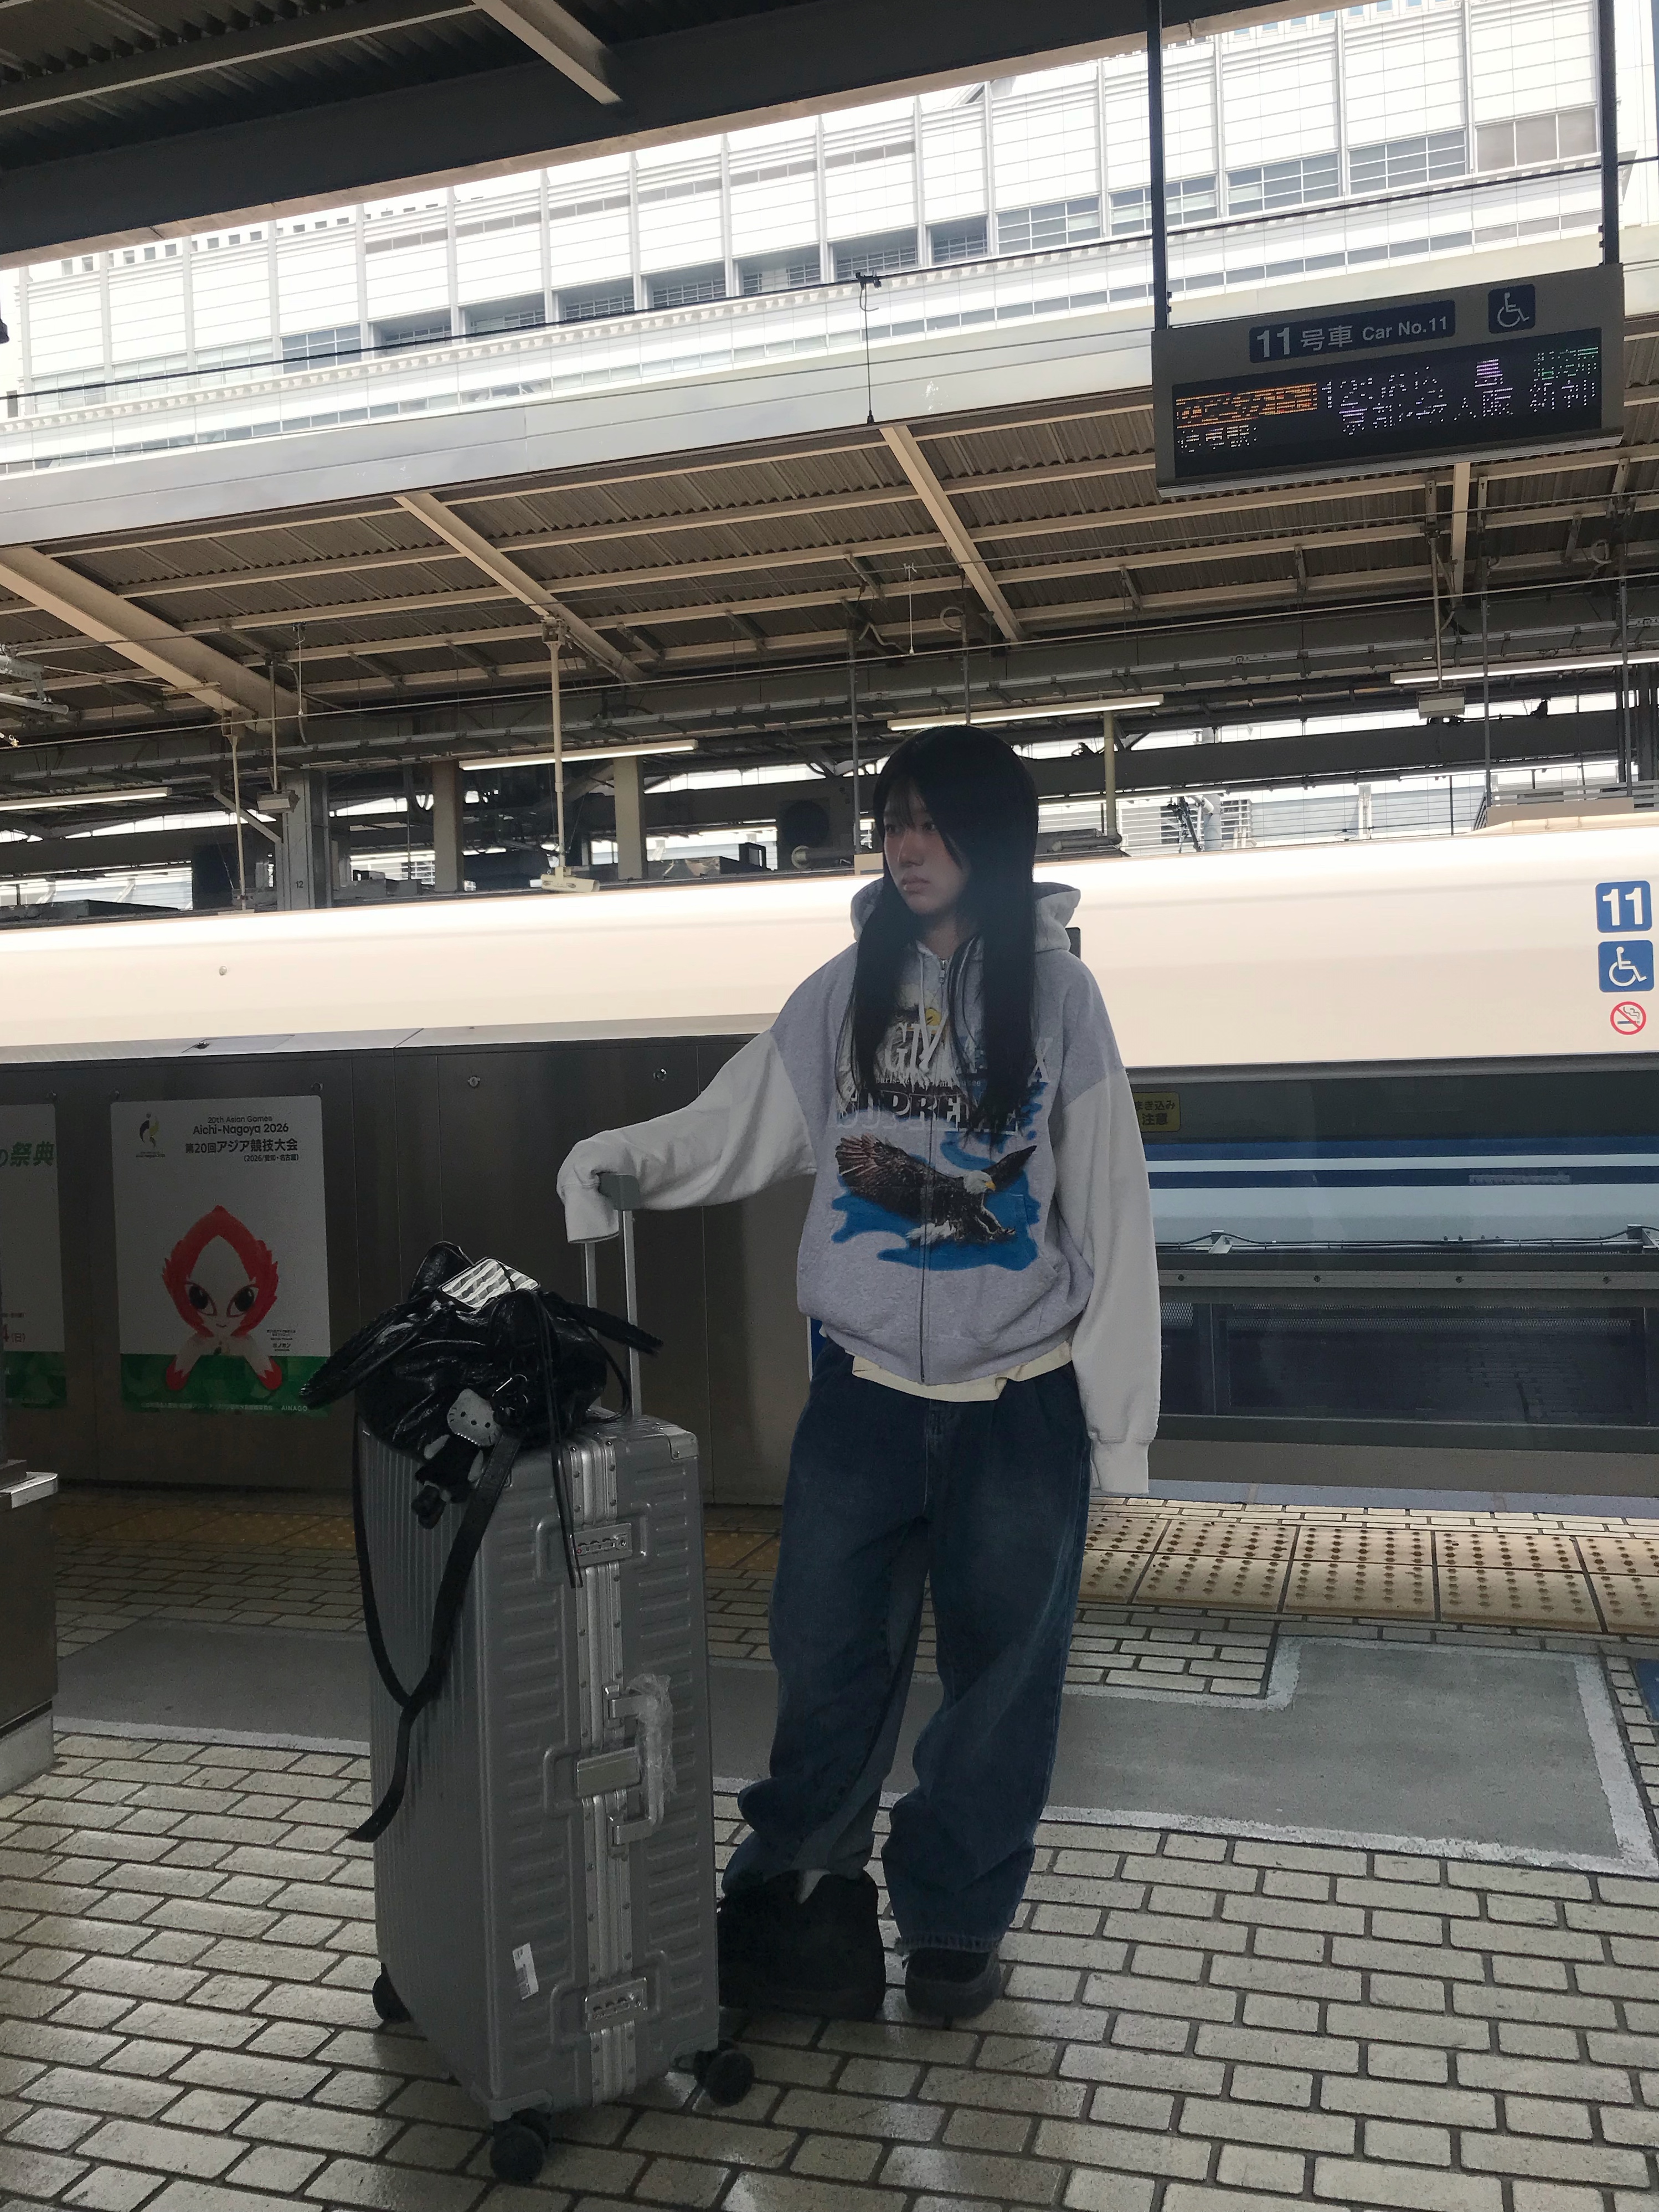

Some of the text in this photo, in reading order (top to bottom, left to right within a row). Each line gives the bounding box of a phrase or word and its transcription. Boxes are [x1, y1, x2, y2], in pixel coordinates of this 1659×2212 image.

[1256, 316, 1447, 358] 11号車 Car No.11
[1603, 887, 1643, 925] 11
[1142, 1112, 1168, 1125] 注意
[193, 1123, 288, 1136] Aichi-Nagoya 2026
[186, 1138, 298, 1153] 第20回アジア競技大会
